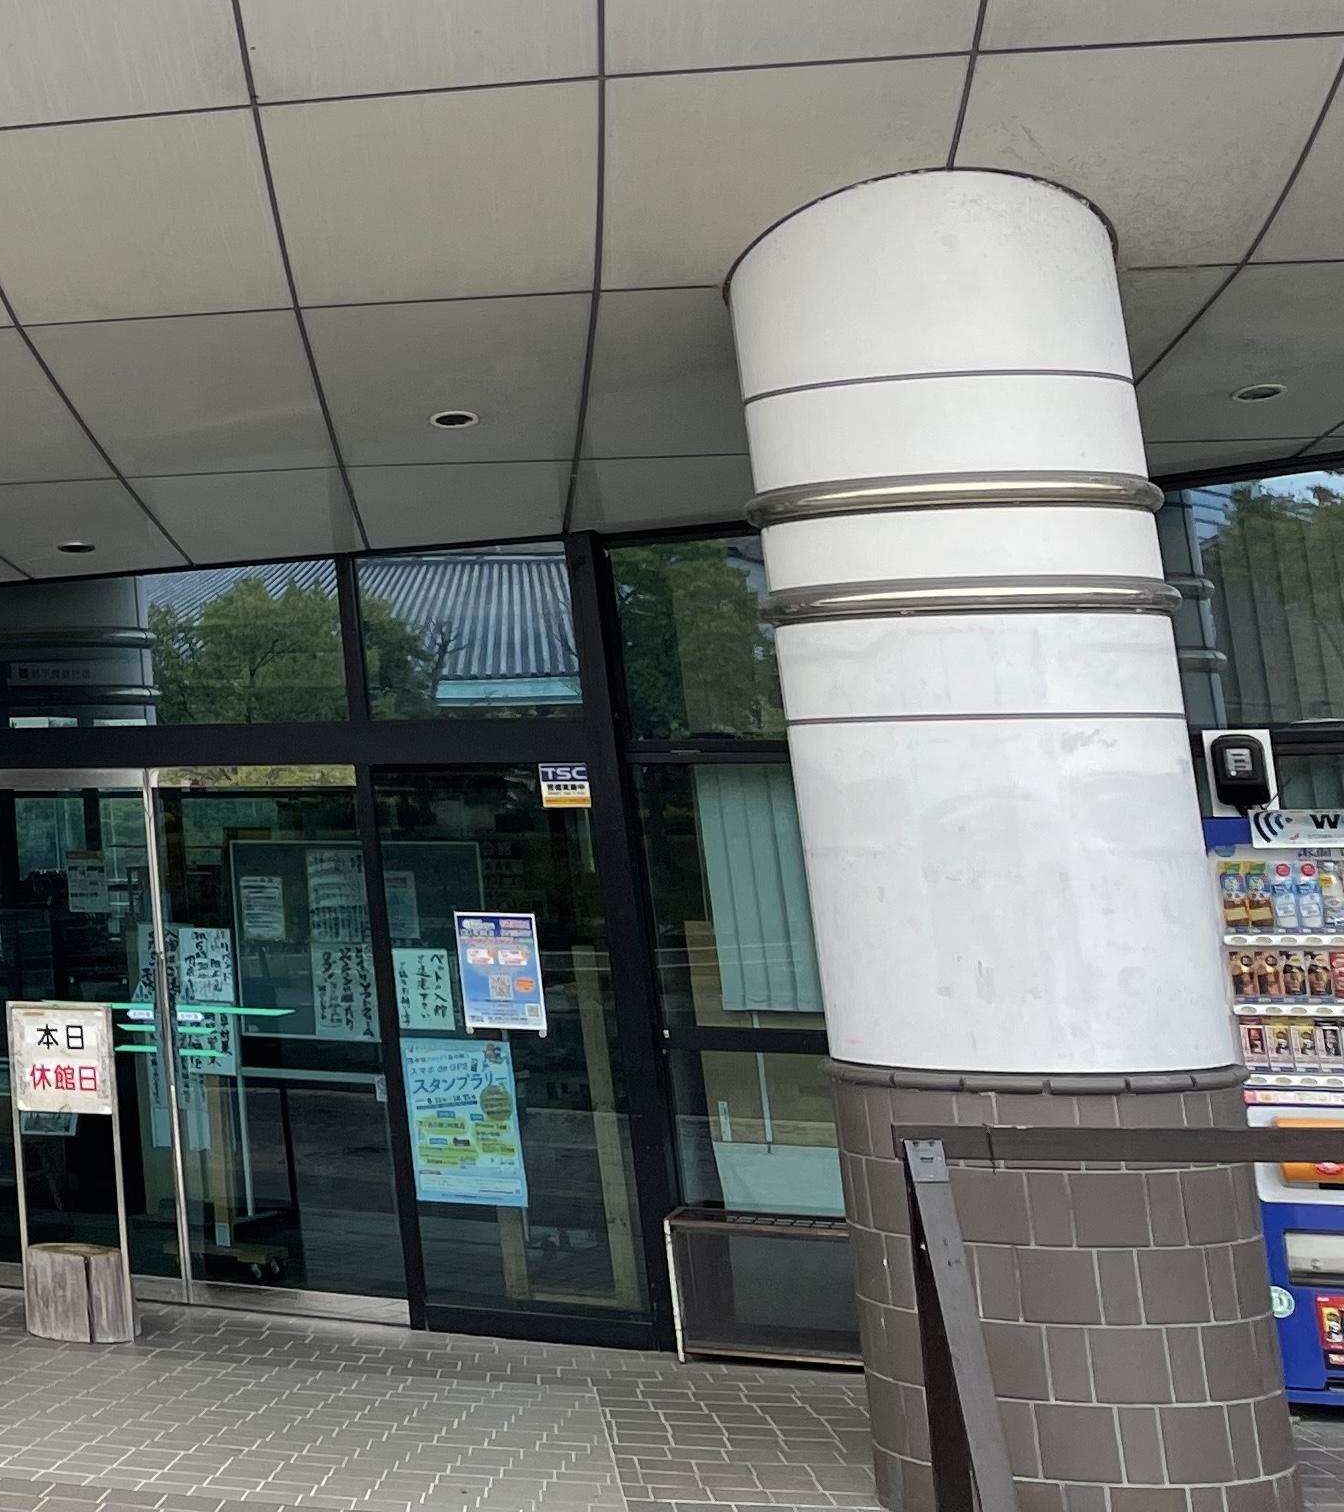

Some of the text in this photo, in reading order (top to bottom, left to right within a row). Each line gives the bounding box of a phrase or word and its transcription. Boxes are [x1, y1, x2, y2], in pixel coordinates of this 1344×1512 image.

[541, 767, 588, 780] TSC
[36, 1024, 84, 1050] 本日
[30, 1064, 97, 1092] 休館日
[413, 1071, 507, 1094] スタンプラリー
